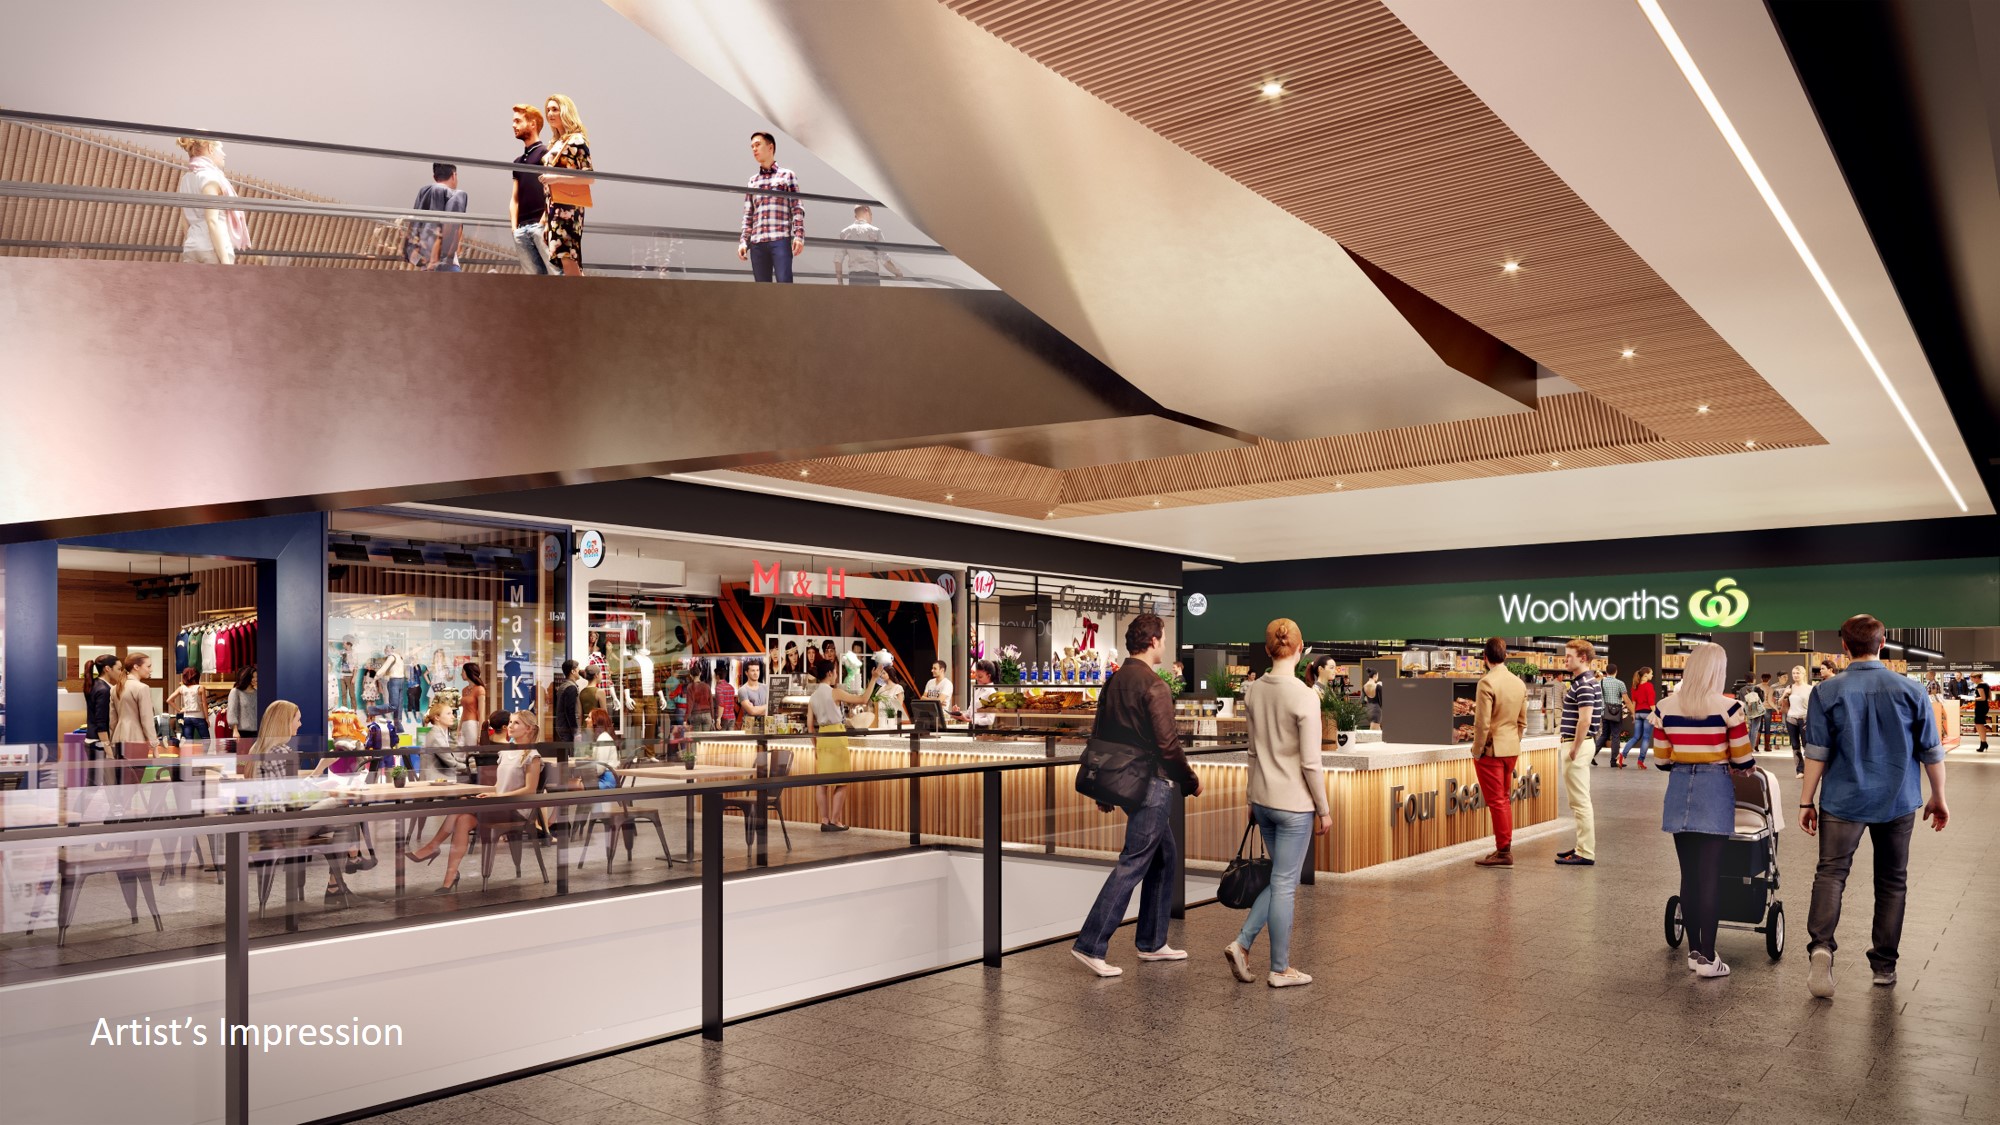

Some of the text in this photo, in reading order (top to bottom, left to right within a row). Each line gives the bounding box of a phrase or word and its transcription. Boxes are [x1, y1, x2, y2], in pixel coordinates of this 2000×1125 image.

[752, 559, 845, 600] M & H
[1498, 589, 1680, 625] Woolworths
[1390, 784, 1439, 828] Four
